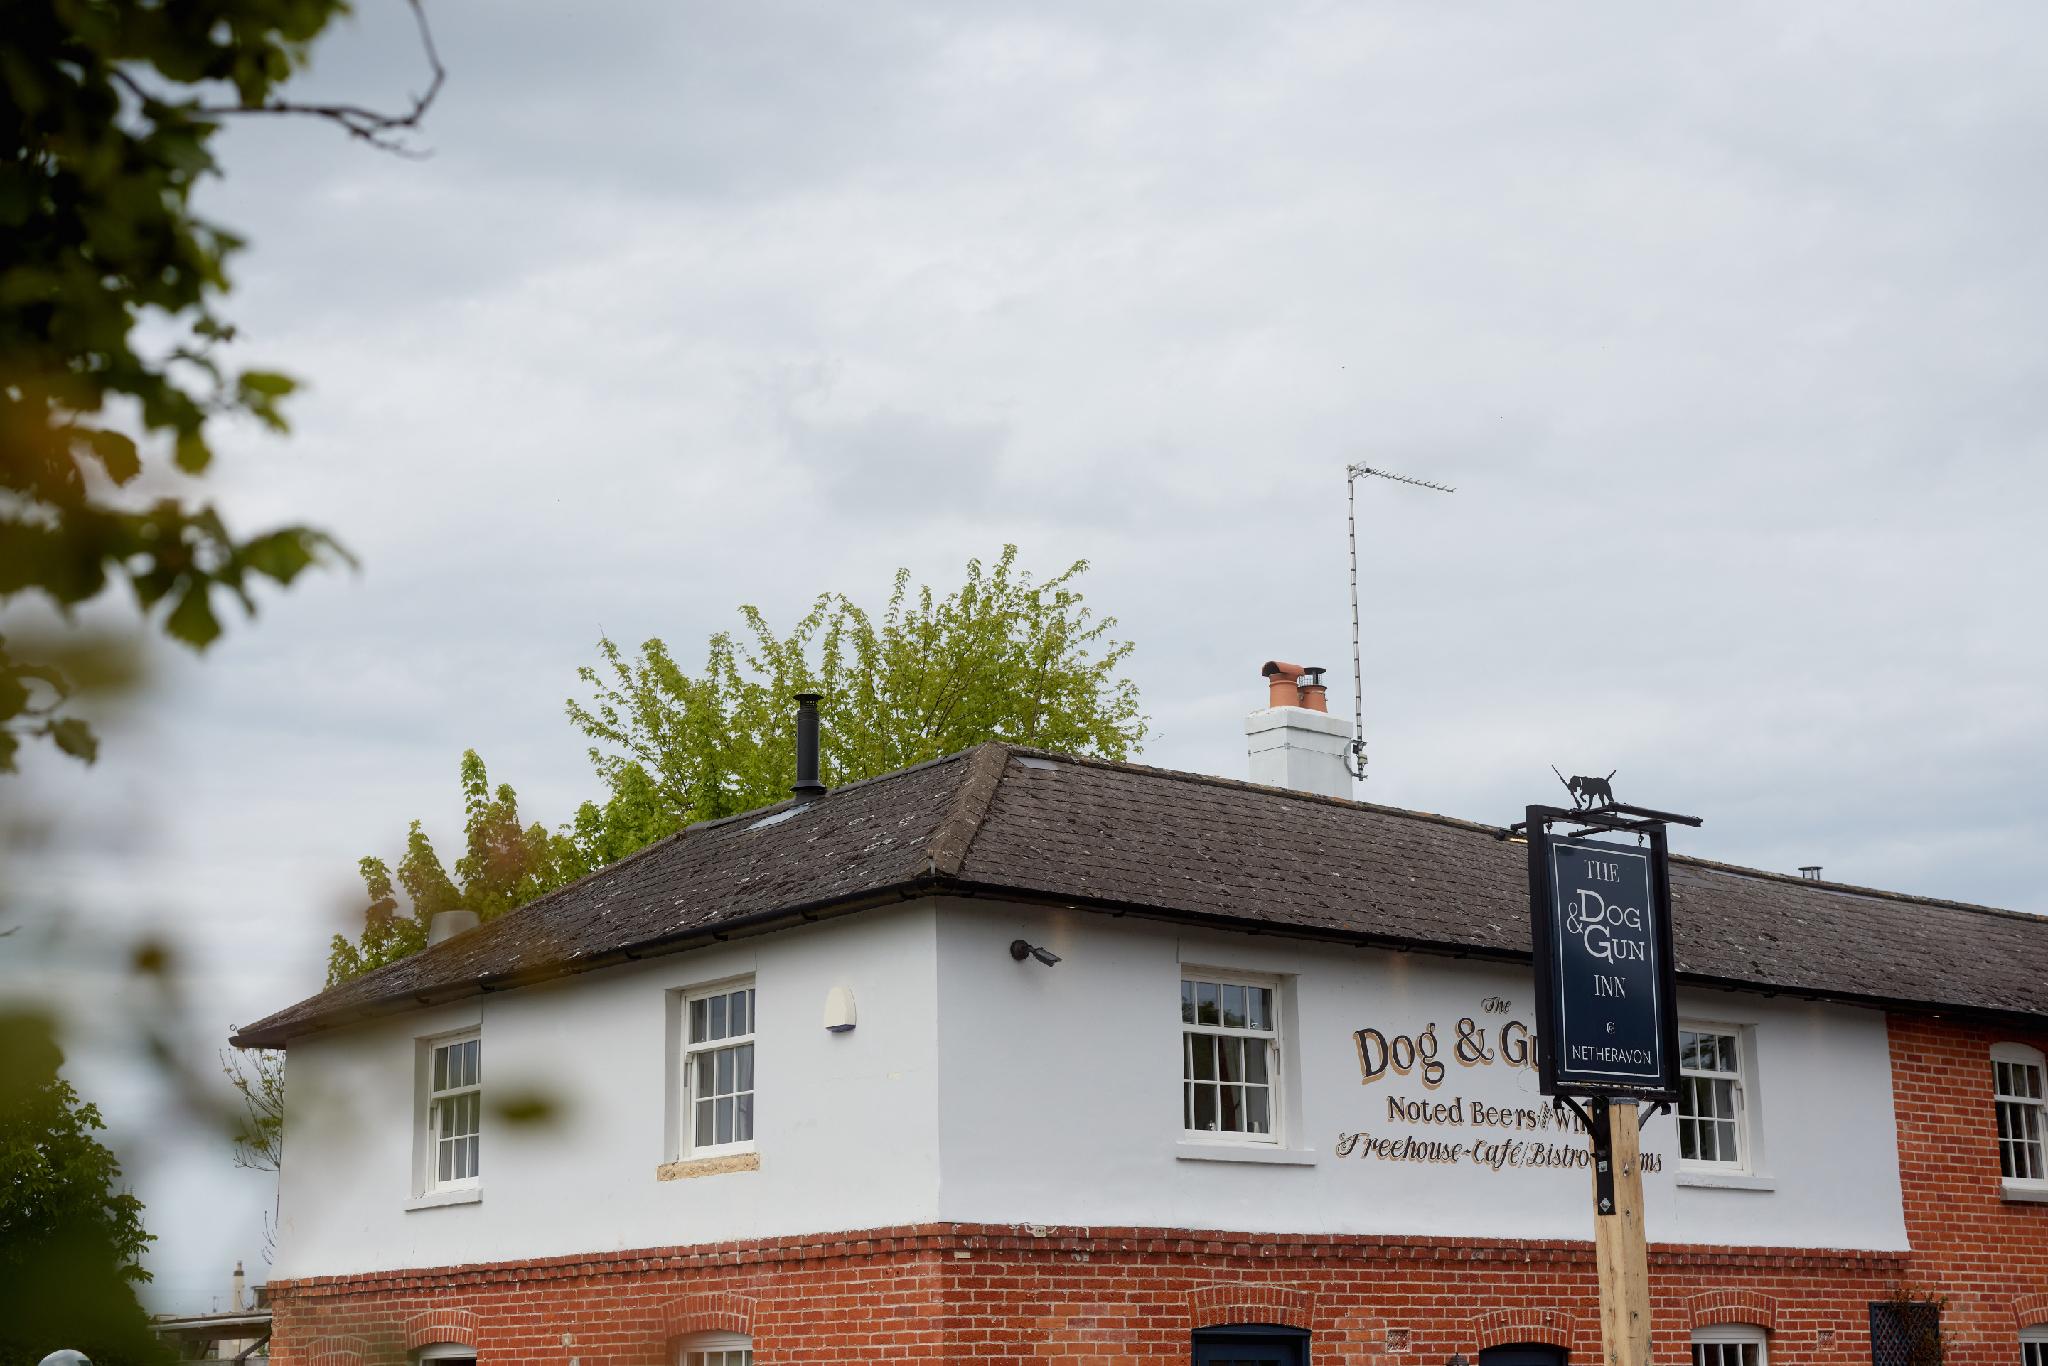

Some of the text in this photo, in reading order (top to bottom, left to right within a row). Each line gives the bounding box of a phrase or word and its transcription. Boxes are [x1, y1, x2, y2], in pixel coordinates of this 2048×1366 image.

[1584, 860, 1620, 883] THE
[1566, 902, 1584, 934] &
[1593, 974, 1626, 999] INN
[1481, 996, 1512, 1014] The
[1353, 1022, 1446, 1088] Dog
[1455, 1017, 1494, 1067] &
[1572, 1044, 1652, 1066] NETHERAVON
[1387, 1095, 1463, 1125] Noted
[1471, 1101, 1537, 1131] Beers
